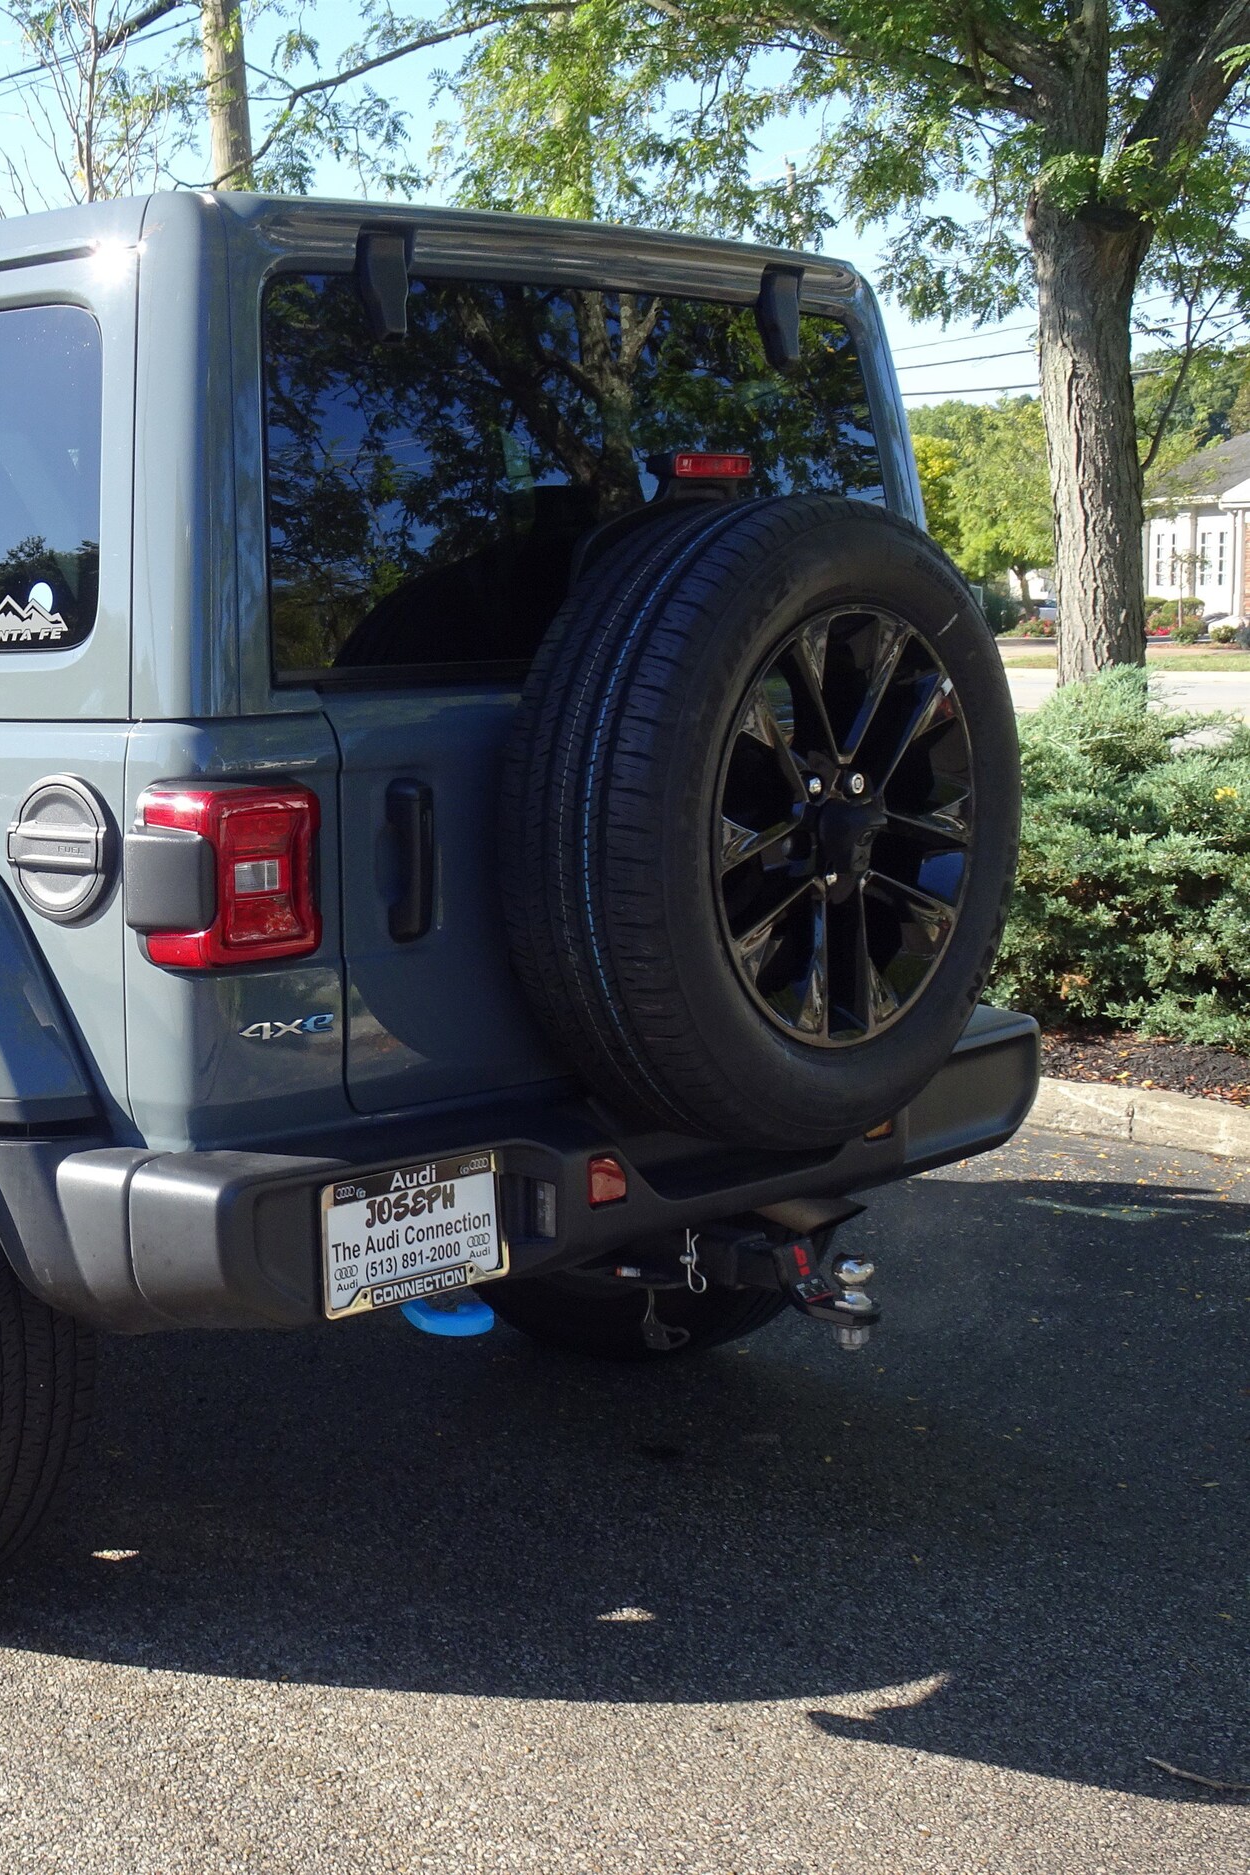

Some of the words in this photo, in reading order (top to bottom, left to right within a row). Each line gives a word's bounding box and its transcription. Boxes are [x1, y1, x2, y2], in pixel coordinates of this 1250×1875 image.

[38, 627, 64, 641] FE
[57, 845, 85, 855] FUEL
[389, 1165, 437, 1192] Audi
[365, 1183, 456, 1228] JOSEPH
[331, 1241, 361, 1264] The
[364, 1228, 400, 1256] Audi
[404, 1211, 492, 1246] Connection
[365, 1255, 398, 1283] (513)
[401, 1240, 461, 1270] 891-2000
[468, 1246, 491, 1260] Audi
[336, 1279, 359, 1293] Audi
[373, 1267, 466, 1306] CONNECTION
